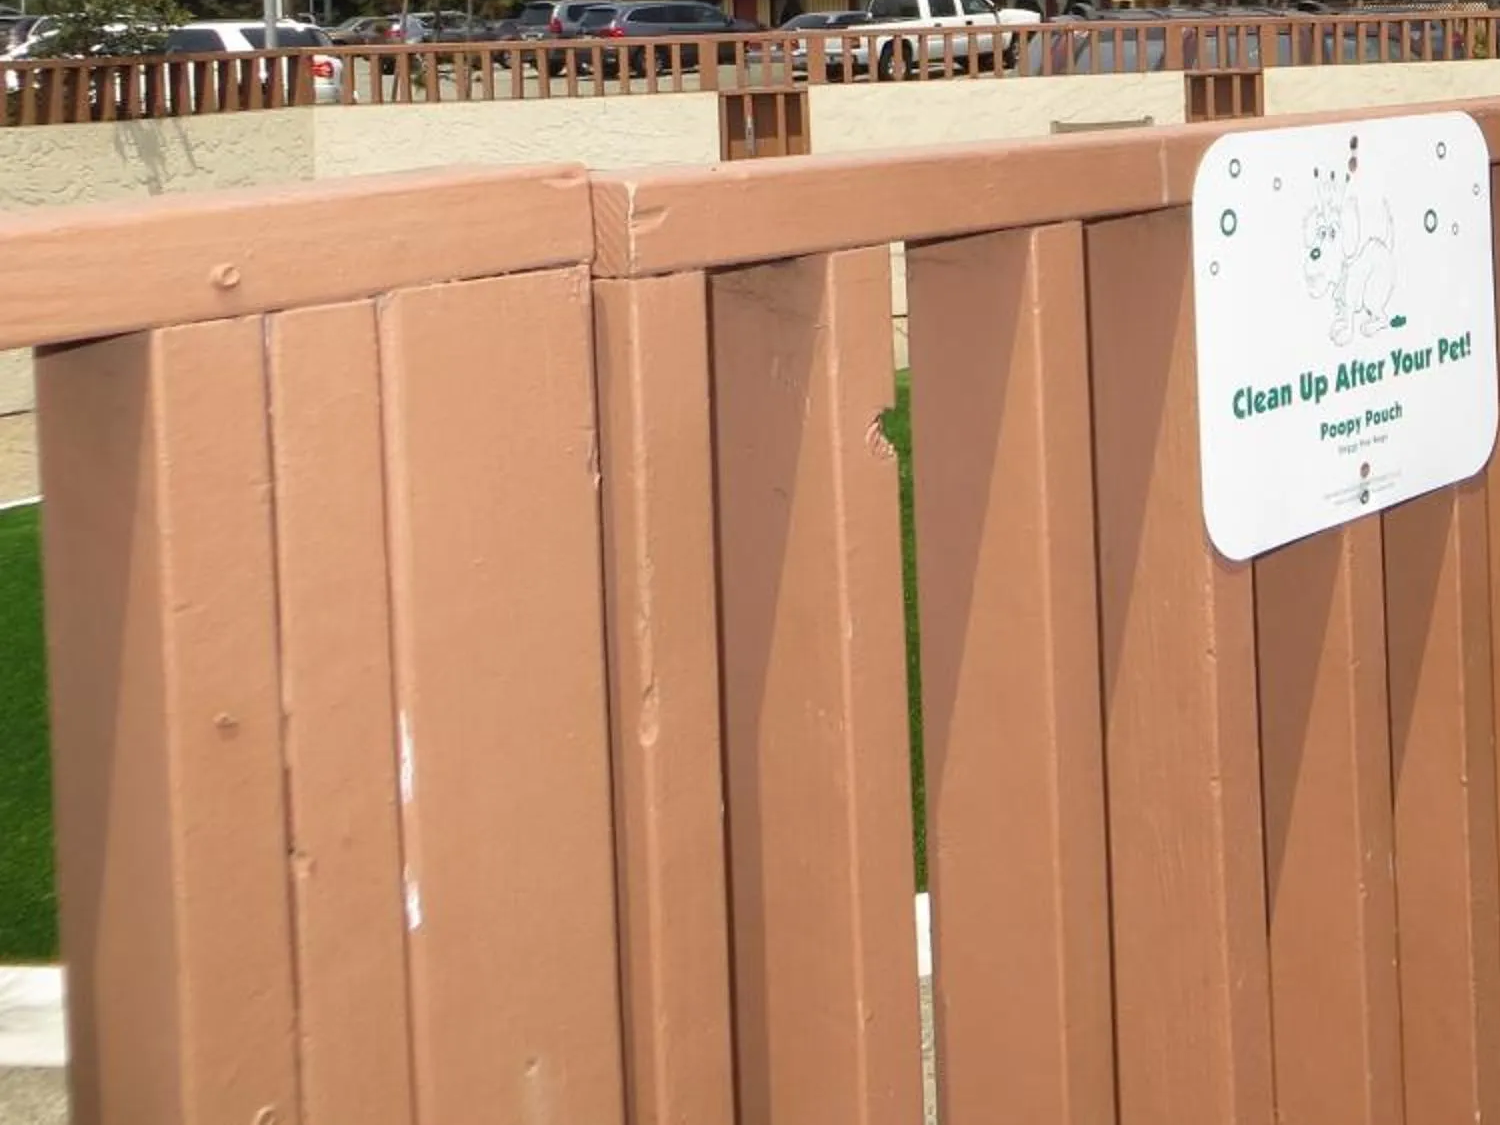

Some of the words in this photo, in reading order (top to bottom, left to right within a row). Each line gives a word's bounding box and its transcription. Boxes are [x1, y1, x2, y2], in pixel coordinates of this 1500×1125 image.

[1232, 384, 1293, 419] Clean
[1299, 372, 1328, 404] Up
[1335, 359, 1385, 393] After
[1390, 347, 1433, 376] Your
[1438, 331, 1472, 364] Pet!
[1320, 415, 1361, 440] Poopy
[1365, 401, 1403, 427] Pouch
